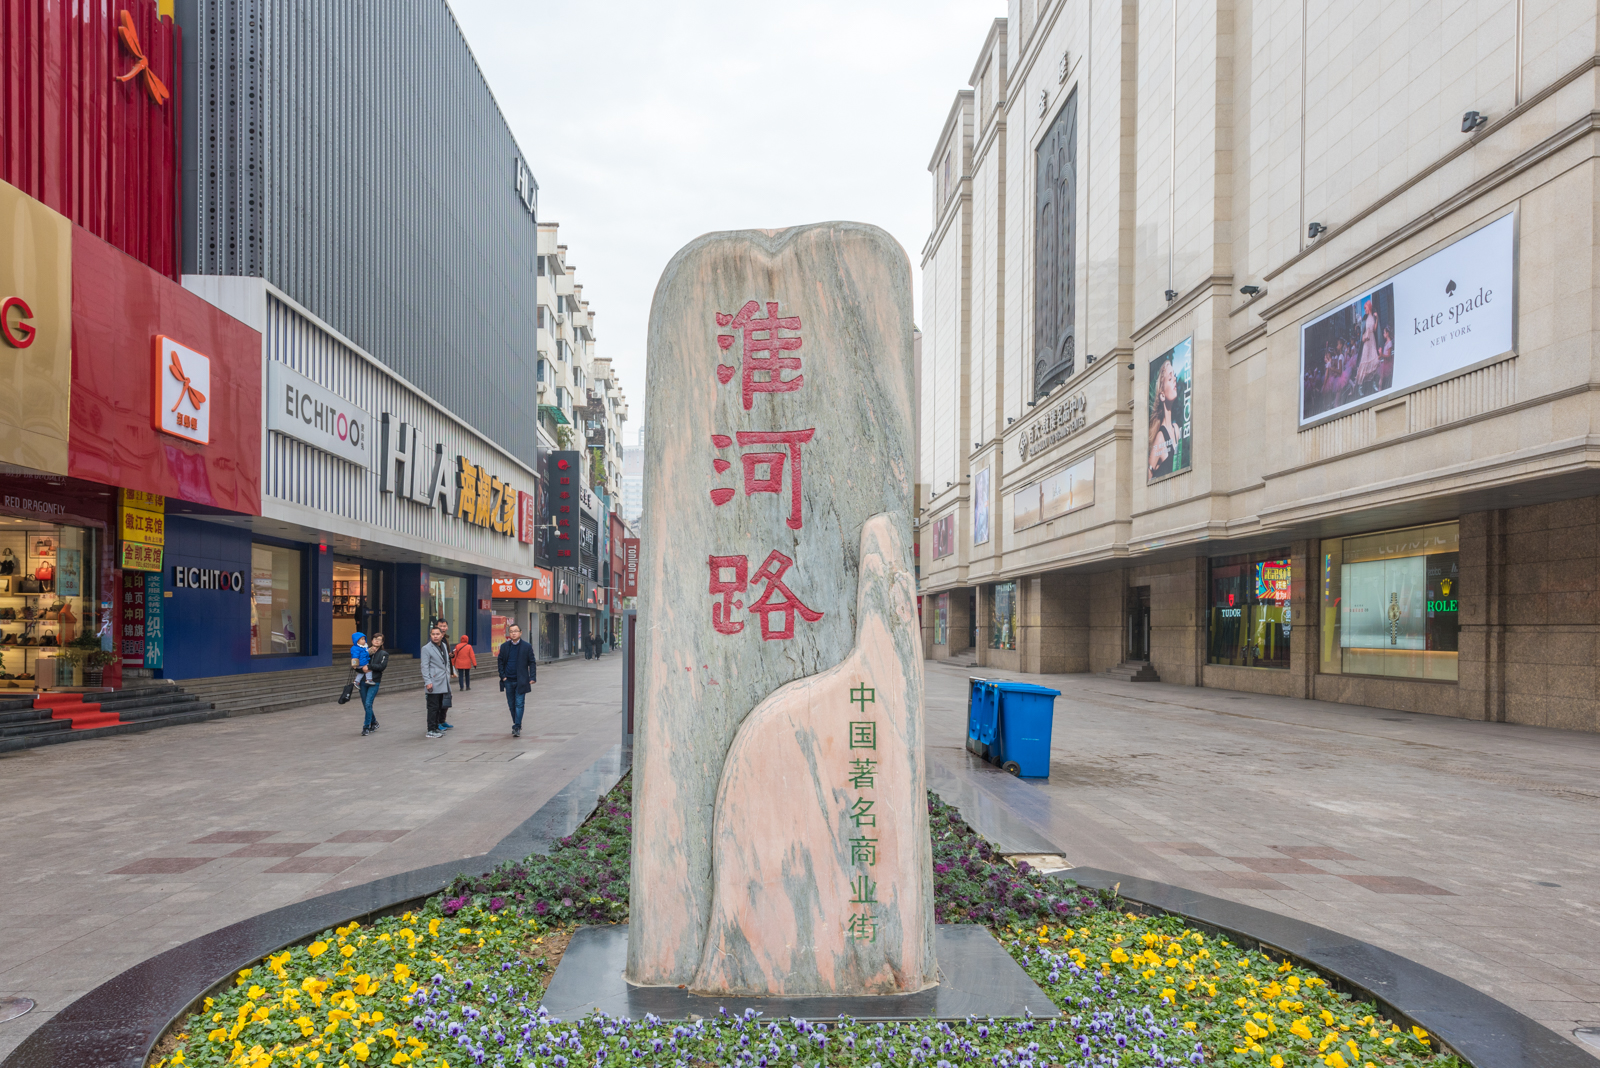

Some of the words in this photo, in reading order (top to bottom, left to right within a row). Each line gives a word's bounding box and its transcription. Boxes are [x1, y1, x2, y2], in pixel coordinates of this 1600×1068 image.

[1, 296, 36, 349] G
[1413, 309, 1443, 335] kate
[1448, 287, 1493, 324] spade
[1430, 333, 1448, 349] NEW
[1449, 324, 1472, 341] YORK
[285, 383, 360, 447] EICHITOO
[382, 412, 453, 515] HLA
[709, 300, 825, 641] 淮河路
[4, 495, 20, 508] RED
[22, 498, 66, 515] DRAGONFLY
[454, 456, 517, 537] 海澜之家
[125, 544, 161, 564] 金凯宾馆
[628, 545, 638, 572] Tonlion
[176, 566, 242, 591] EICHITOO
[1222, 608, 1242, 618] TUDOR
[1427, 600, 1459, 612] ROLE
[848, 681, 879, 945] 中国著名商业街
